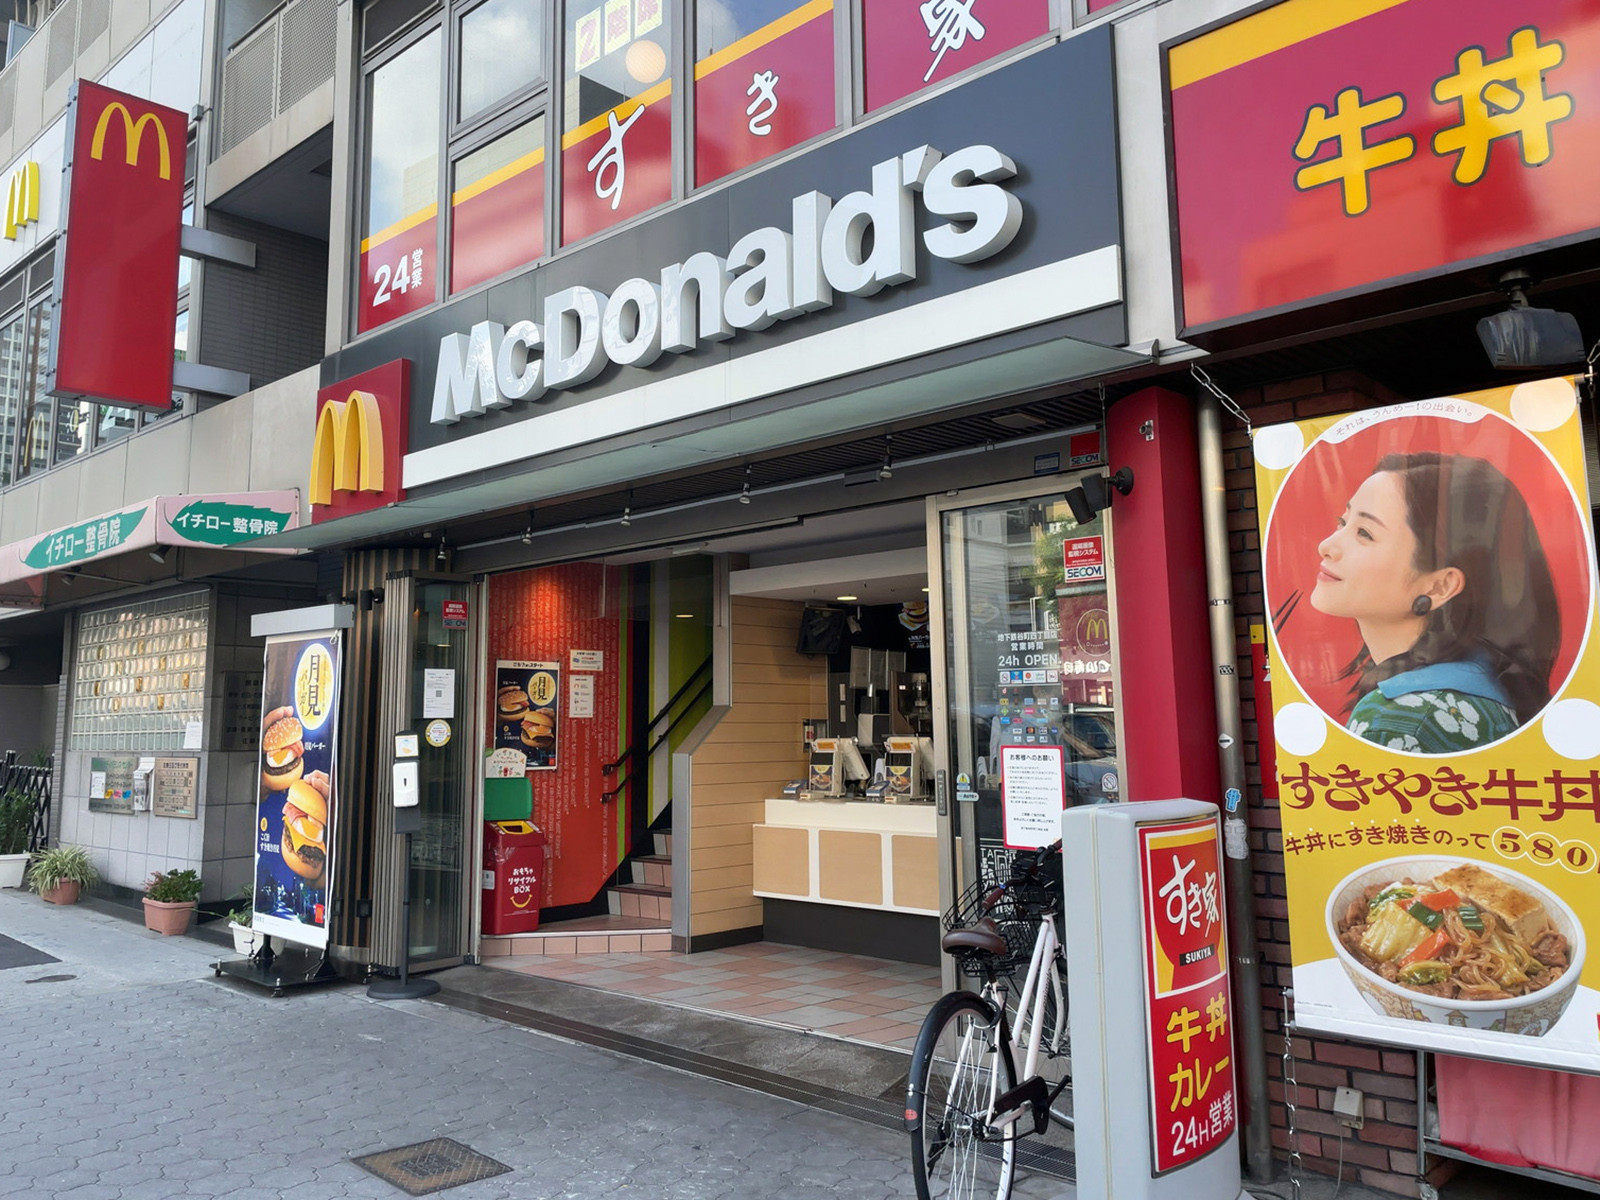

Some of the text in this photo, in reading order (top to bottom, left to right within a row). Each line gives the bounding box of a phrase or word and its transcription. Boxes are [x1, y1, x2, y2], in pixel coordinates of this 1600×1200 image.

[1293, 25, 1575, 217] 牛丼
[429, 143, 1023, 425] McDonald's
[45, 517, 122, 564] イチロー整骨院
[176, 512, 279, 536] イチロー整骨院
[1067, 565, 1102, 578] SECOM
[307, 654, 321, 717] 月見
[998, 654, 1020, 667] 24h
[1025, 653, 1058, 667] OPEN
[537, 676, 548, 701] 月見
[1009, 753, 1055, 763] お客様へのお願い
[1280, 761, 1600, 825] すきやき牛丼
[513, 885, 531, 894] BOX
[1158, 854, 1220, 939] すき家
[1185, 947, 1212, 964] SUKIYA
[1166, 992, 1228, 1054] 牛丼
[1168, 1056, 1230, 1113] カレー
[1170, 1089, 1233, 1157] 24H営業
